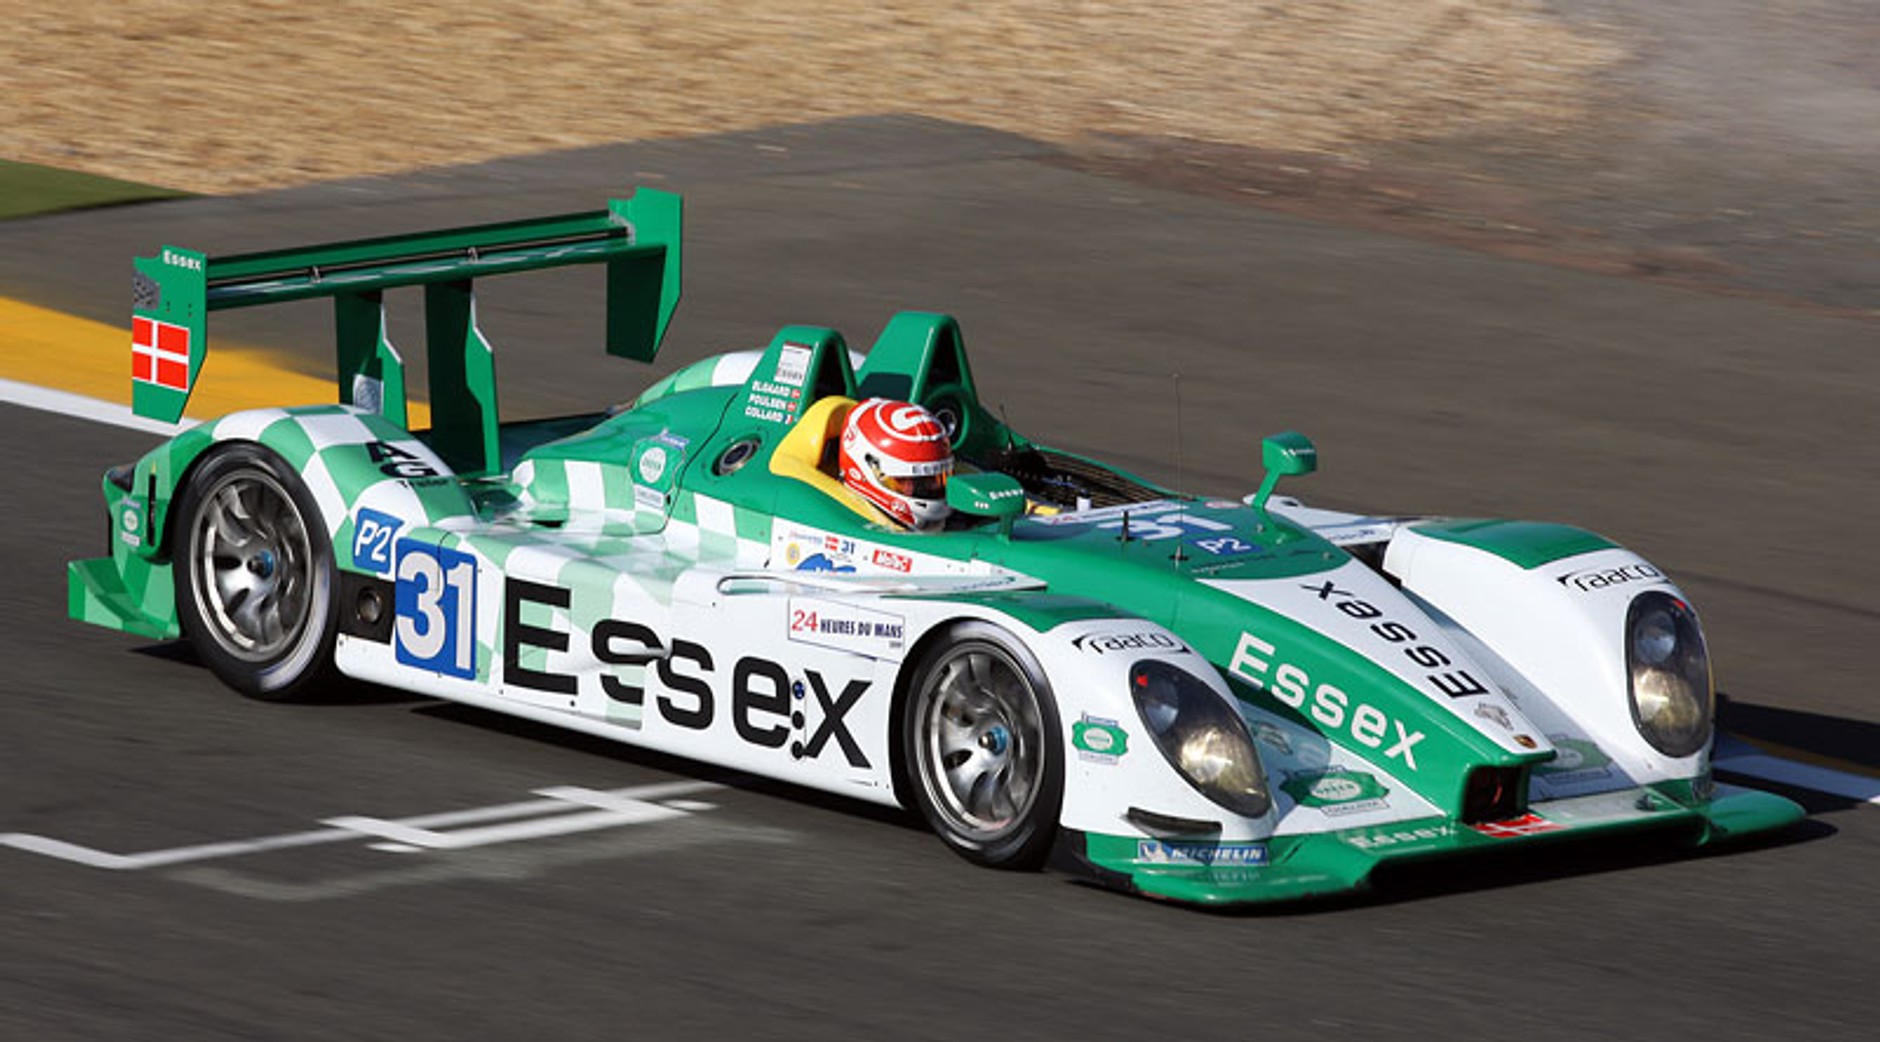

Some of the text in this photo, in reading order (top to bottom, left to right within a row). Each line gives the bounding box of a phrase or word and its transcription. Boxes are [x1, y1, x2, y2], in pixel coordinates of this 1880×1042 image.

[163, 250, 202, 272] Essex
[1097, 513, 1233, 540] 31
[355, 521, 393, 563] P2
[841, 540, 856, 555] 31
[1196, 537, 1253, 555] P2
[399, 551, 473, 671] 31
[791, 608, 903, 639] 24 HEURES DU MANS
[1300, 580, 1489, 700] Essex
[503, 576, 873, 769] Essex
[1229, 632, 1425, 771] Essex
[1347, 826, 1457, 849] Essex
[1171, 847, 1262, 860] MICHELIN
